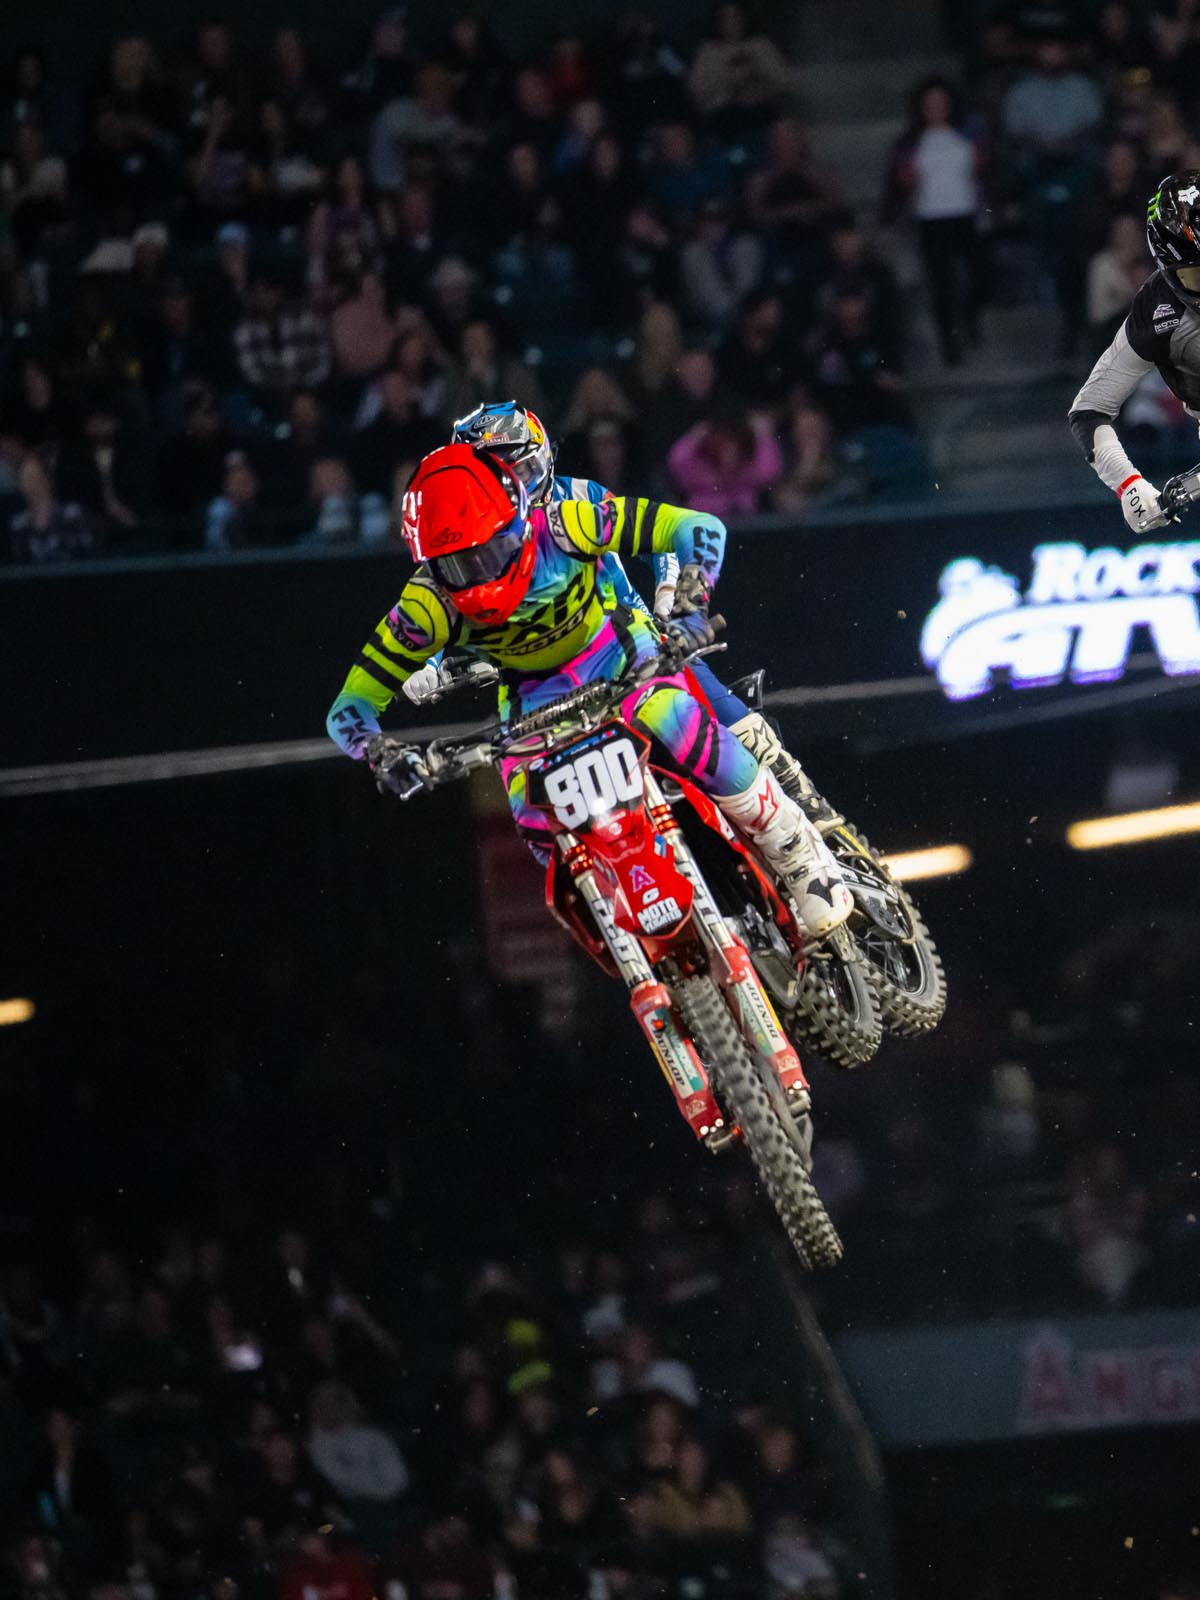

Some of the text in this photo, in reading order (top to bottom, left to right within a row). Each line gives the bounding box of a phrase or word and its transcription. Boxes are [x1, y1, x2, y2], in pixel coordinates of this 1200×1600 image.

[550, 509, 566, 538] FXR
[1125, 486, 1146, 519] FOX
[544, 737, 643, 831] 800
[637, 896, 679, 924] MOTO
[747, 982, 780, 1039] DUNLOP
[653, 1028, 686, 1087] DUNLOP
